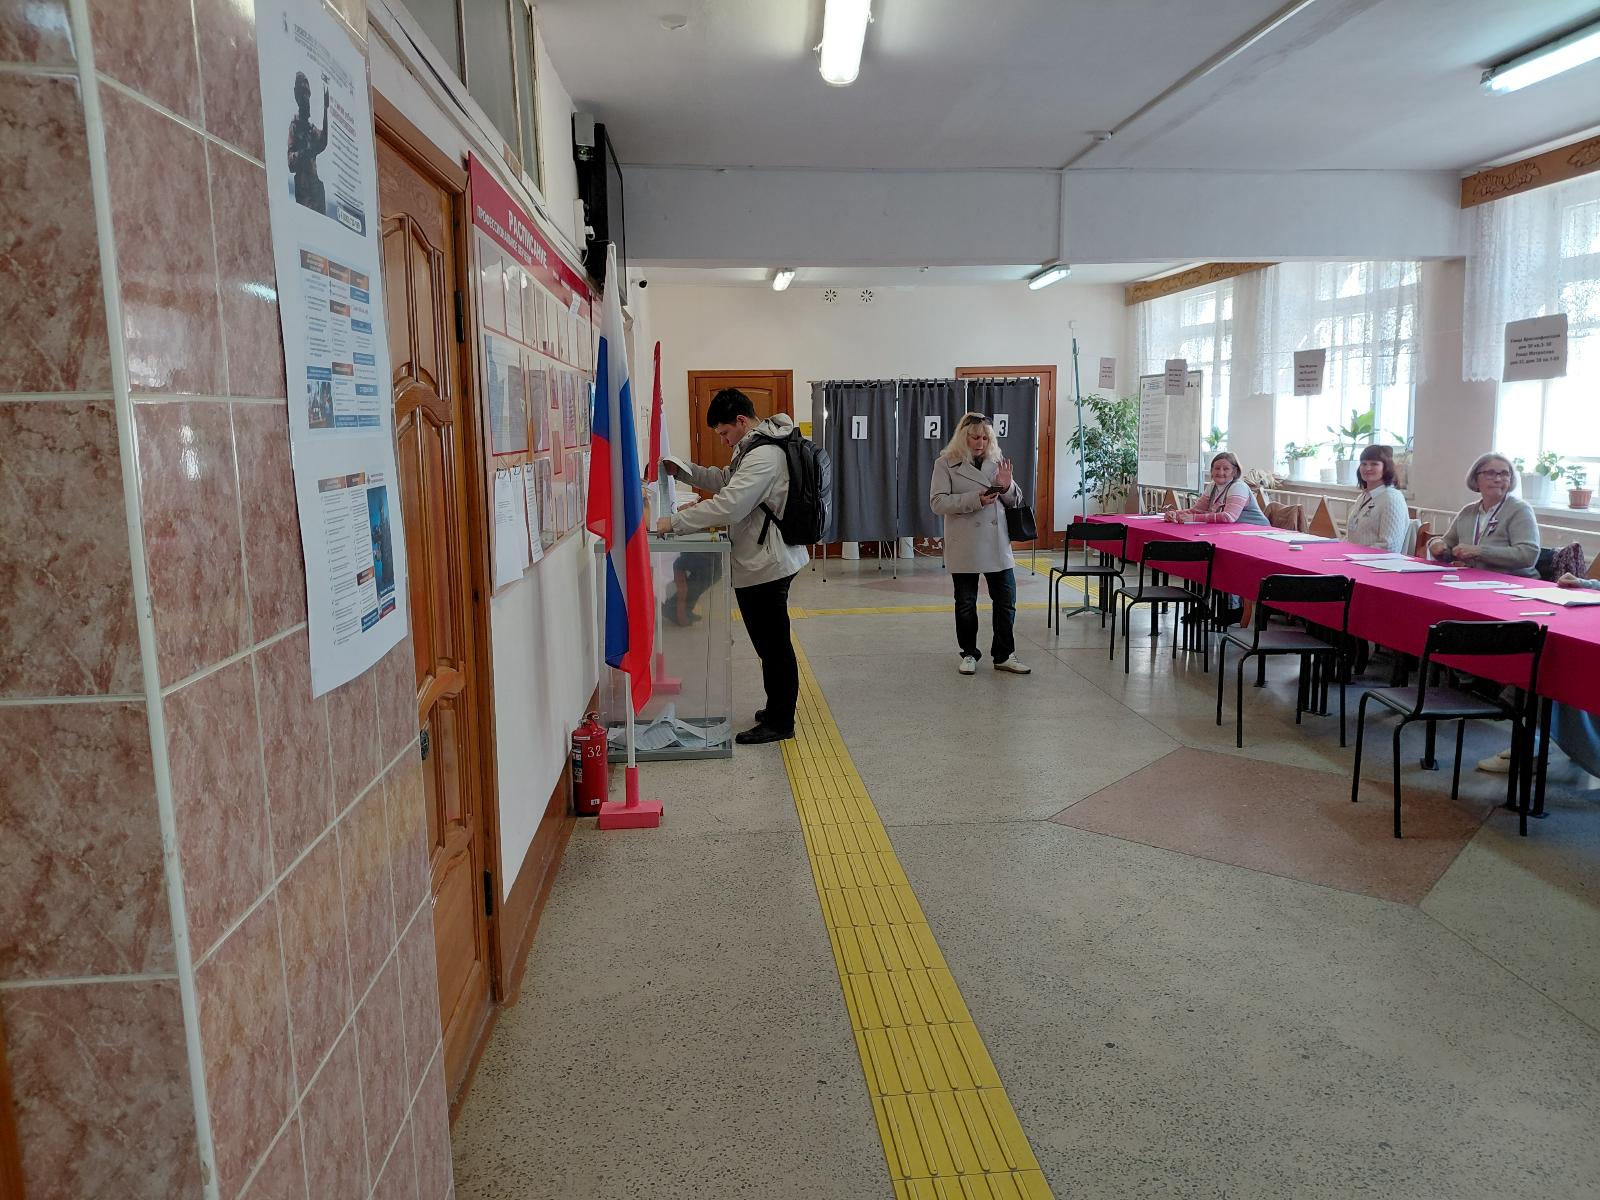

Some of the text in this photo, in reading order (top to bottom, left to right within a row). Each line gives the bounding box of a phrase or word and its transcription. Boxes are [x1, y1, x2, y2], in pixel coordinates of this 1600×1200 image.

[508, 209, 547, 269] РАСПИСАНИЕ
[856, 421, 860, 438] 1
[930, 421, 938, 438] 2
[999, 419, 1006, 436] 3
[587, 745, 601, 757] 32
